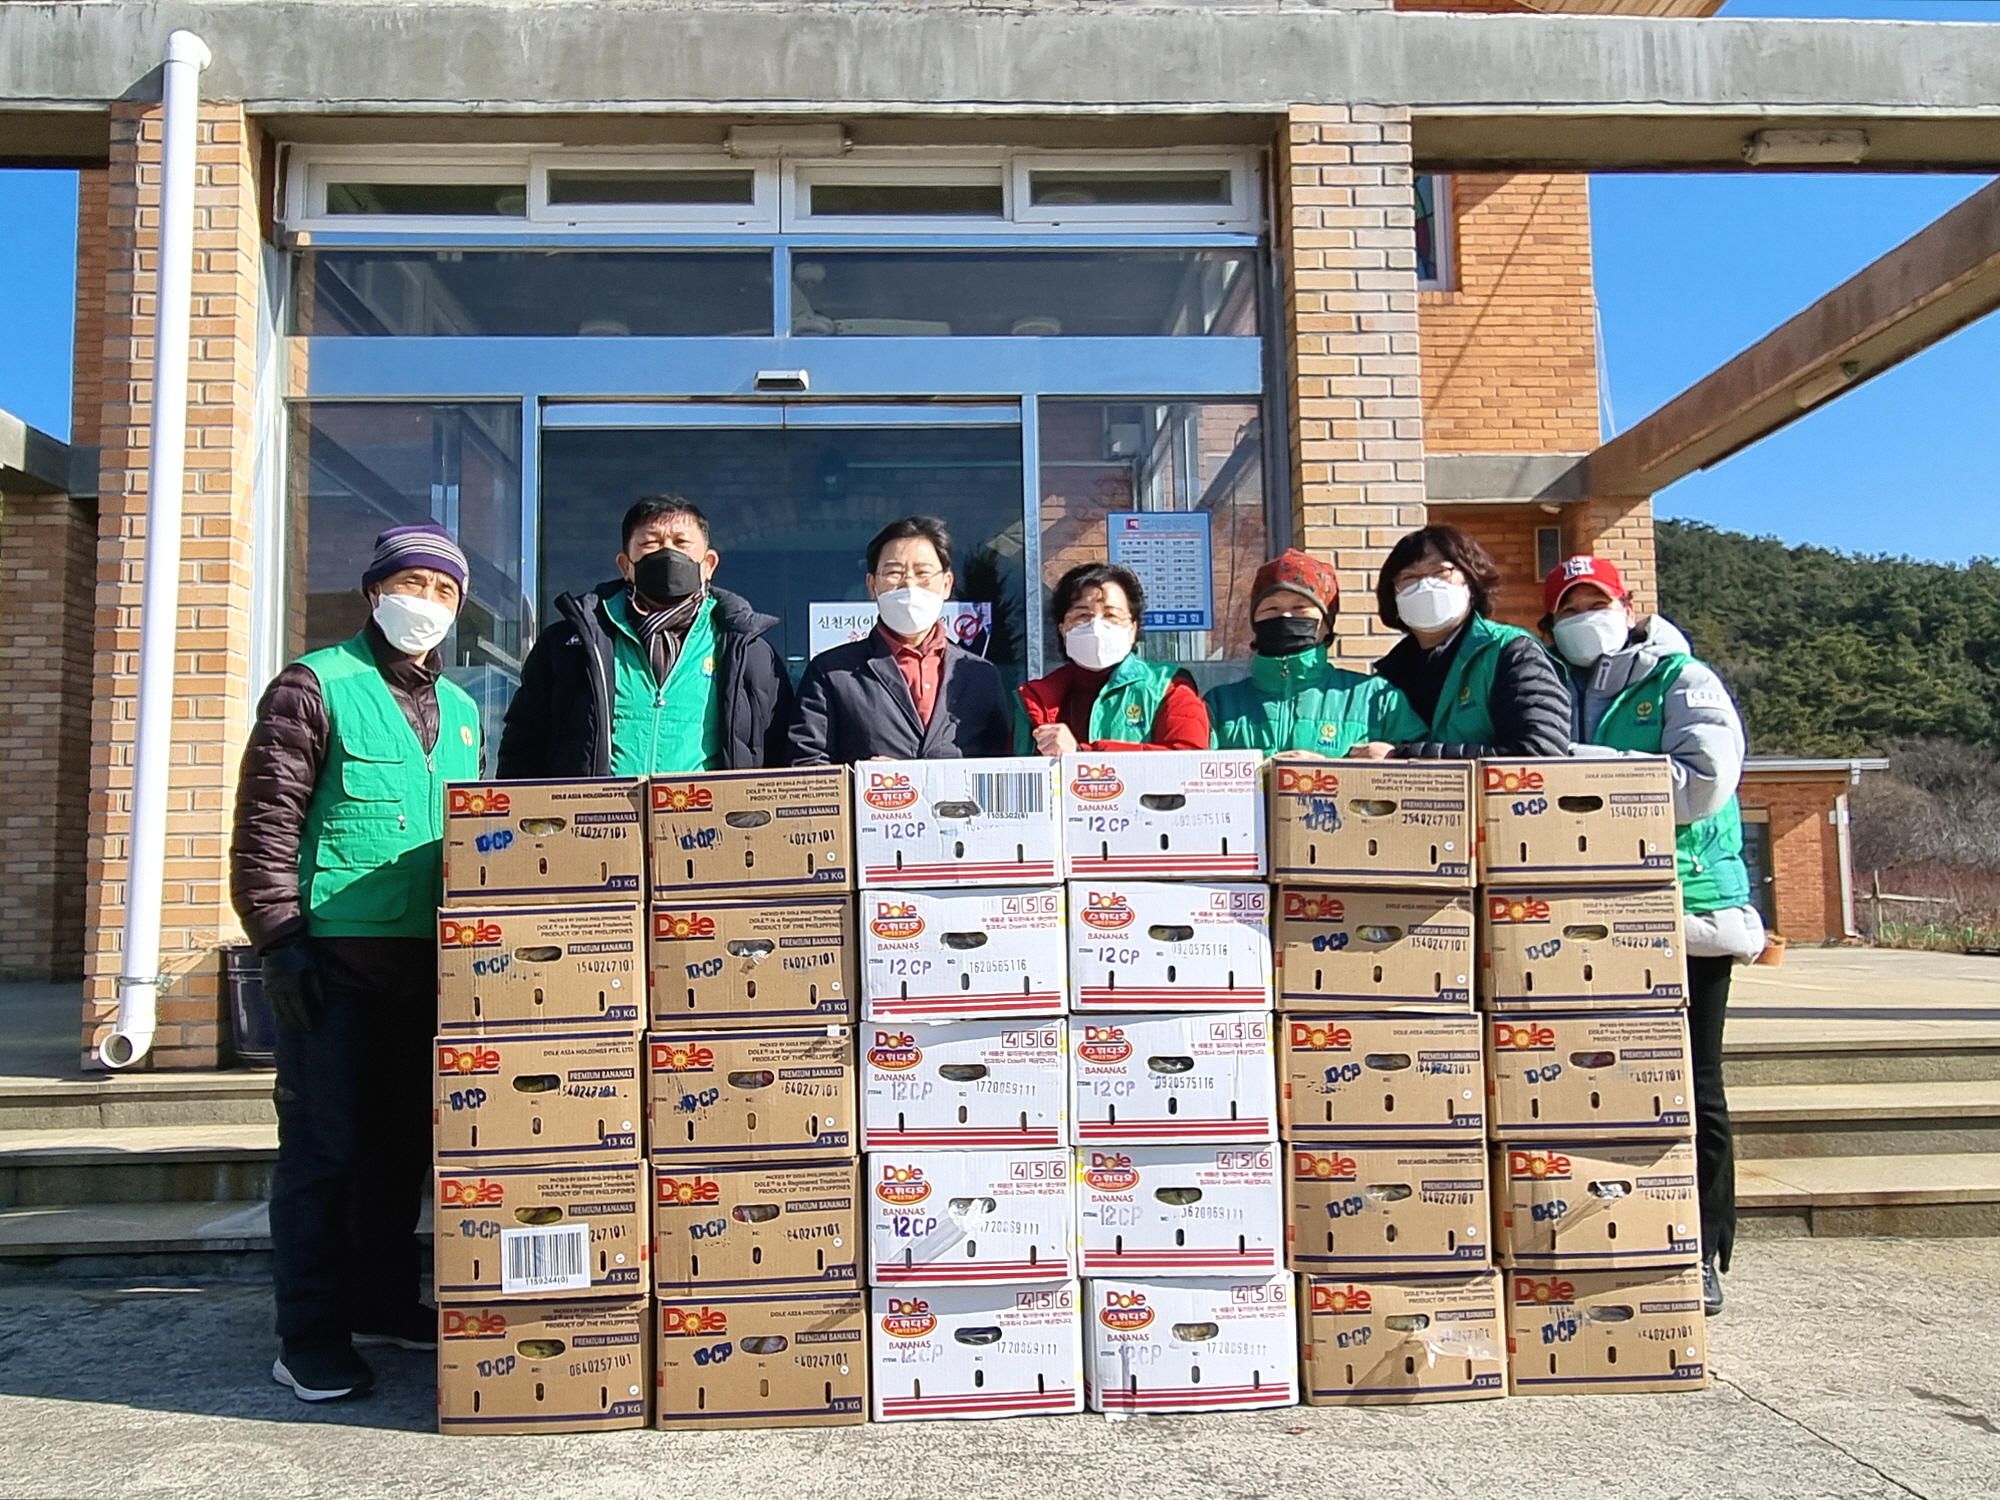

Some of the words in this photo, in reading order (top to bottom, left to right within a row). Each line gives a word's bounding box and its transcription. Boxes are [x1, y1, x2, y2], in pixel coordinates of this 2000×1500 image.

[1077, 763, 1116, 779] Dole
[871, 772, 911, 790] Dole
[1278, 768, 1339, 795] Dole
[1483, 767, 1544, 793] Dole
[450, 789, 511, 814] Dole
[653, 784, 713, 812] Dole
[778, 809, 808, 818] PREMIUM
[808, 807, 838, 816] BANANAS
[1077, 804, 1119, 812] BANANAS
[870, 812, 913, 821] BANANAS
[612, 879, 622, 888] 13
[624, 879, 637, 887] KG
[818, 873, 828, 881] 13
[831, 872, 844, 880] KG
[1089, 892, 1127, 907] Dole
[1284, 893, 1345, 918] Dole
[877, 901, 917, 918] Dole
[1489, 896, 1551, 922] Dole
[440, 918, 502, 945] Dole
[654, 912, 715, 939] Dole
[570, 945, 601, 954] PREMIUM
[601, 943, 632, 952] BANANAS
[780, 938, 812, 947] PREMIUM
[812, 936, 842, 946] BANANAS
[877, 942, 920, 951] BANANAS
[610, 1008, 621, 1018] 13
[623, 1008, 637, 1018] KG
[821, 1003, 832, 1012] 13
[834, 1002, 848, 1011] KG
[875, 1031, 915, 1048] Dole
[1084, 1025, 1124, 1040] Dole
[1291, 1022, 1352, 1048] Dole
[1494, 1022, 1555, 1048] Dole
[438, 1045, 500, 1072] Dole
[652, 1042, 714, 1069] Dole
[570, 1070, 601, 1080] PREMIUM
[602, 1068, 634, 1079] BANANAS
[780, 1069, 812, 1079] PREMIUM
[812, 1067, 843, 1078] BANANAS
[874, 1073, 916, 1081] BANANAS
[1085, 1066, 1127, 1074] BANANAS
[607, 1137, 618, 1146] 13
[619, 1136, 634, 1146] KG
[821, 1136, 832, 1145] 13
[834, 1135, 848, 1144] KG
[1092, 1152, 1132, 1170] Dole
[1294, 1152, 1357, 1179] Dole
[1510, 1151, 1571, 1178] Dole
[884, 1164, 924, 1182] Dole
[441, 1178, 504, 1206] Dole
[657, 1176, 719, 1204] Dole
[787, 1201, 819, 1212] PREMIUM
[819, 1199, 850, 1210] BANANAS
[1091, 1194, 1134, 1202] BANANAS
[570, 1204, 601, 1215] PREMIUM
[602, 1202, 634, 1213] BANANAS
[883, 1208, 926, 1216] BANANAS
[611, 1271, 622, 1281] 13
[623, 1270, 638, 1280] KG
[828, 1269, 840, 1278] 13
[841, 1268, 855, 1278] KG
[1514, 1276, 1576, 1303] Dole
[888, 1297, 929, 1315] Dole
[1106, 1290, 1147, 1308] Dole
[1312, 1285, 1372, 1313] Dole
[443, 1309, 507, 1337] Dole
[664, 1306, 727, 1335] Dole
[573, 1337, 605, 1347] PREMIUM
[606, 1334, 638, 1345] BANANAS
[797, 1332, 829, 1343] PREMIUM
[829, 1331, 860, 1341] BANANAS
[1107, 1333, 1150, 1342] BANANAS
[889, 1340, 931, 1350] BANANAS
[613, 1406, 626, 1415] 13
[627, 1404, 642, 1414] KG
[834, 1401, 846, 1411] 13
[847, 1400, 861, 1410] KG
